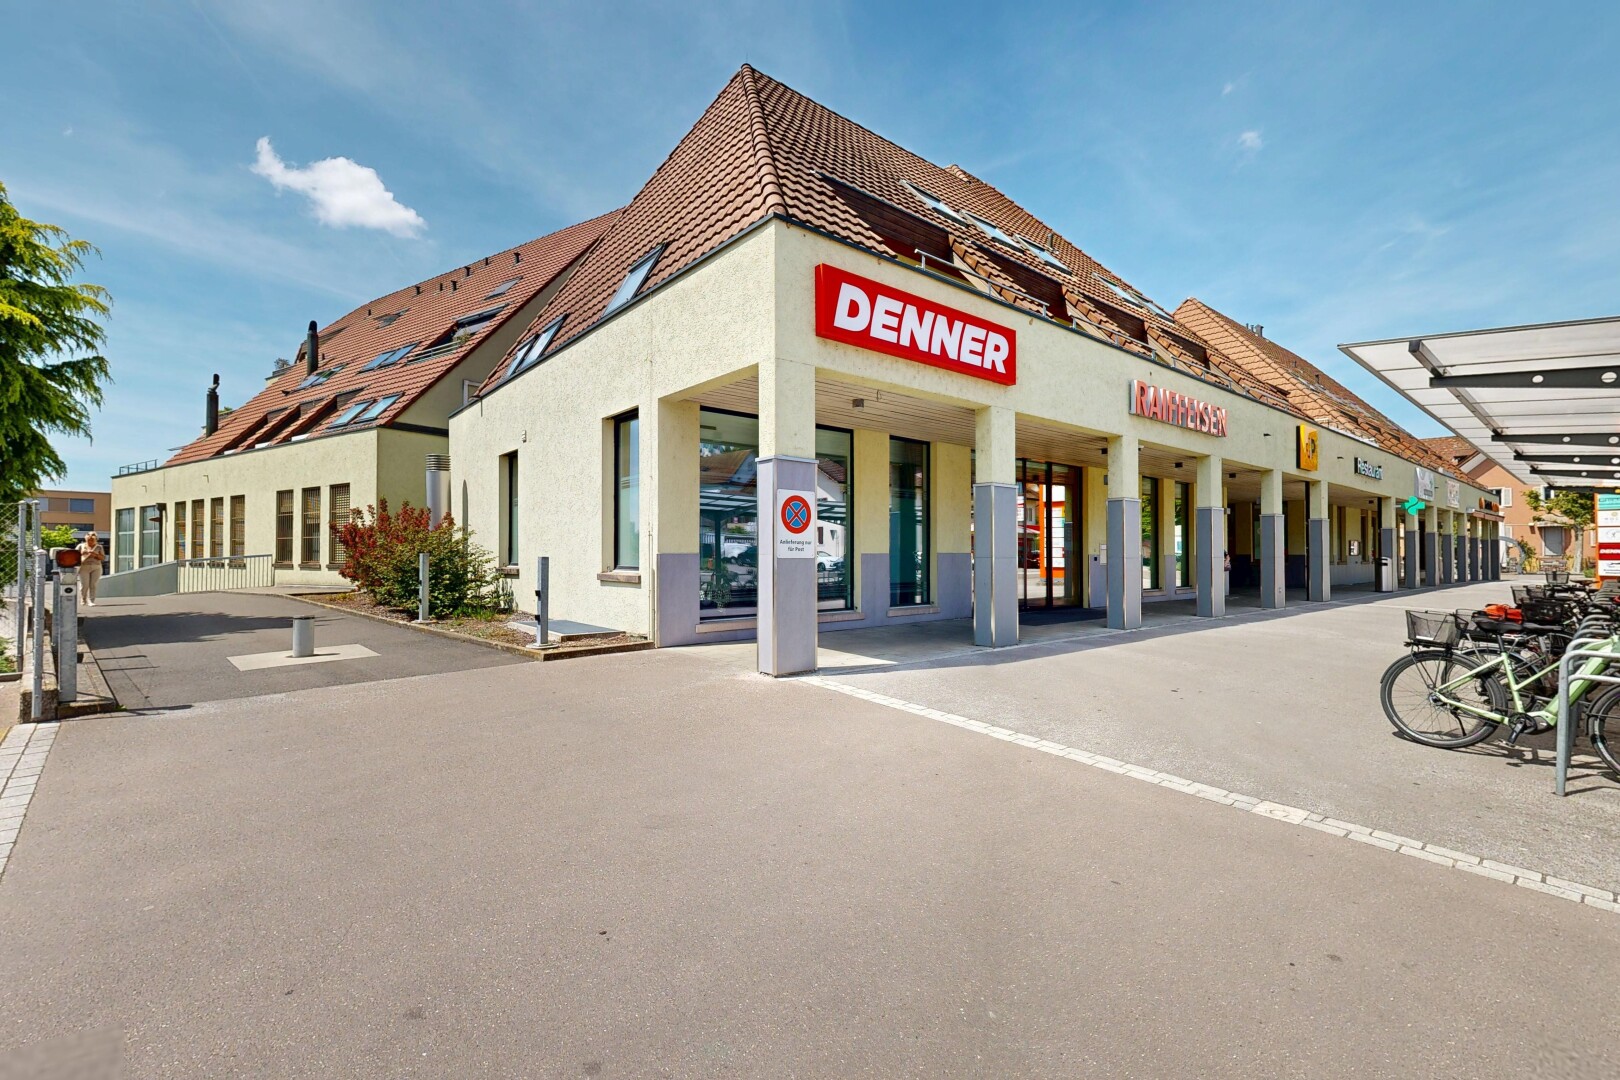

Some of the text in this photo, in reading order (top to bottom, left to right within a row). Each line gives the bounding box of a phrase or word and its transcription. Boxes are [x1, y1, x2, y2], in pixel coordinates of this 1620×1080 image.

[833, 282, 1009, 374] DENNER
[1133, 379, 1228, 437] RAIFFEISEN
[1356, 457, 1384, 480] Restaurant
